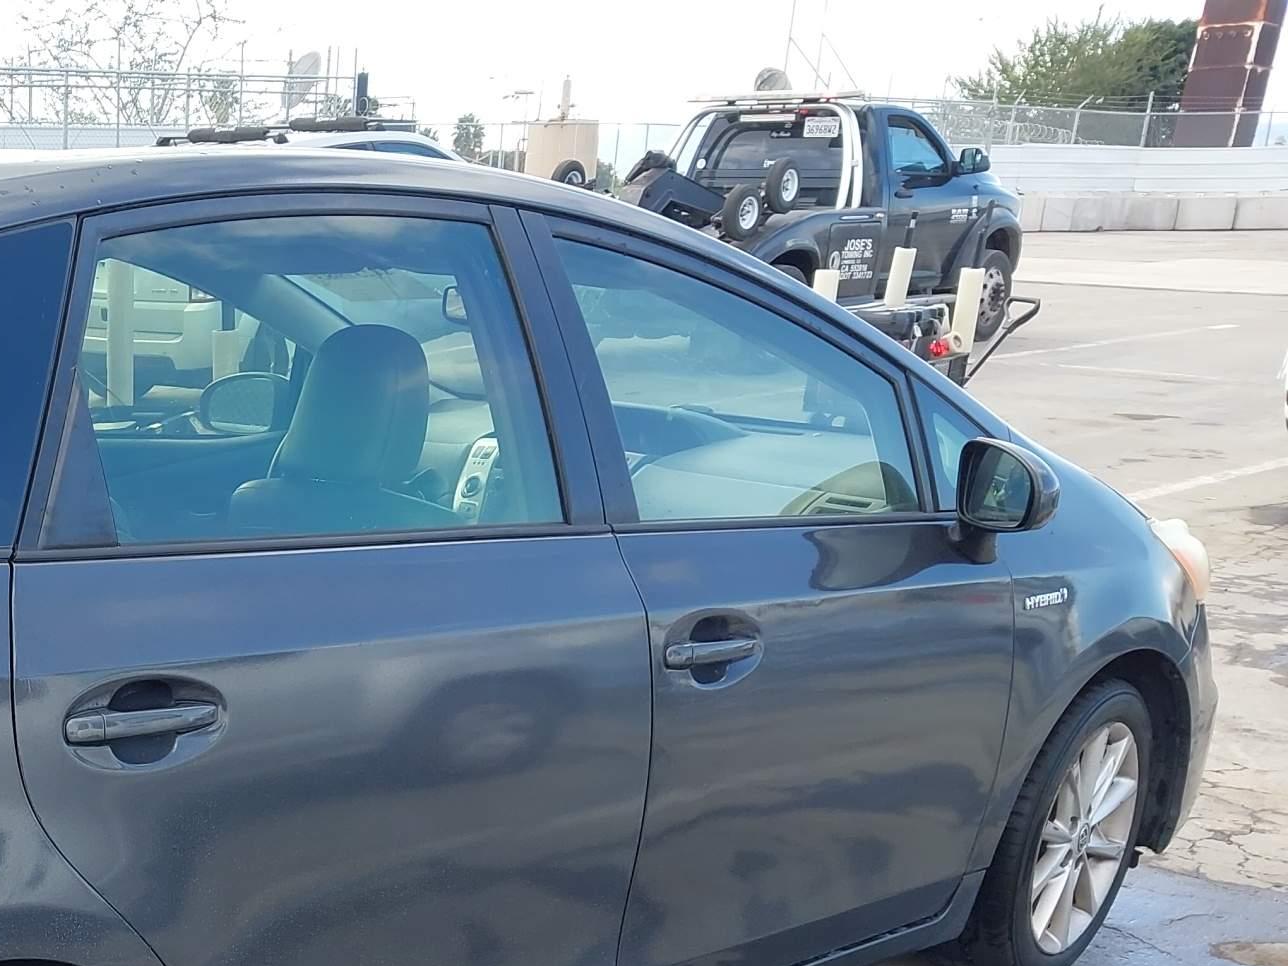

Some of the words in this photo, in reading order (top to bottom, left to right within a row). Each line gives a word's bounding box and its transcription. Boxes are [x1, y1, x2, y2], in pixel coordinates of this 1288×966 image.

[844, 238, 873, 251] JOSE'S
[863, 250, 874, 258] INC
[1024, 591, 1062, 610] HYBRID
